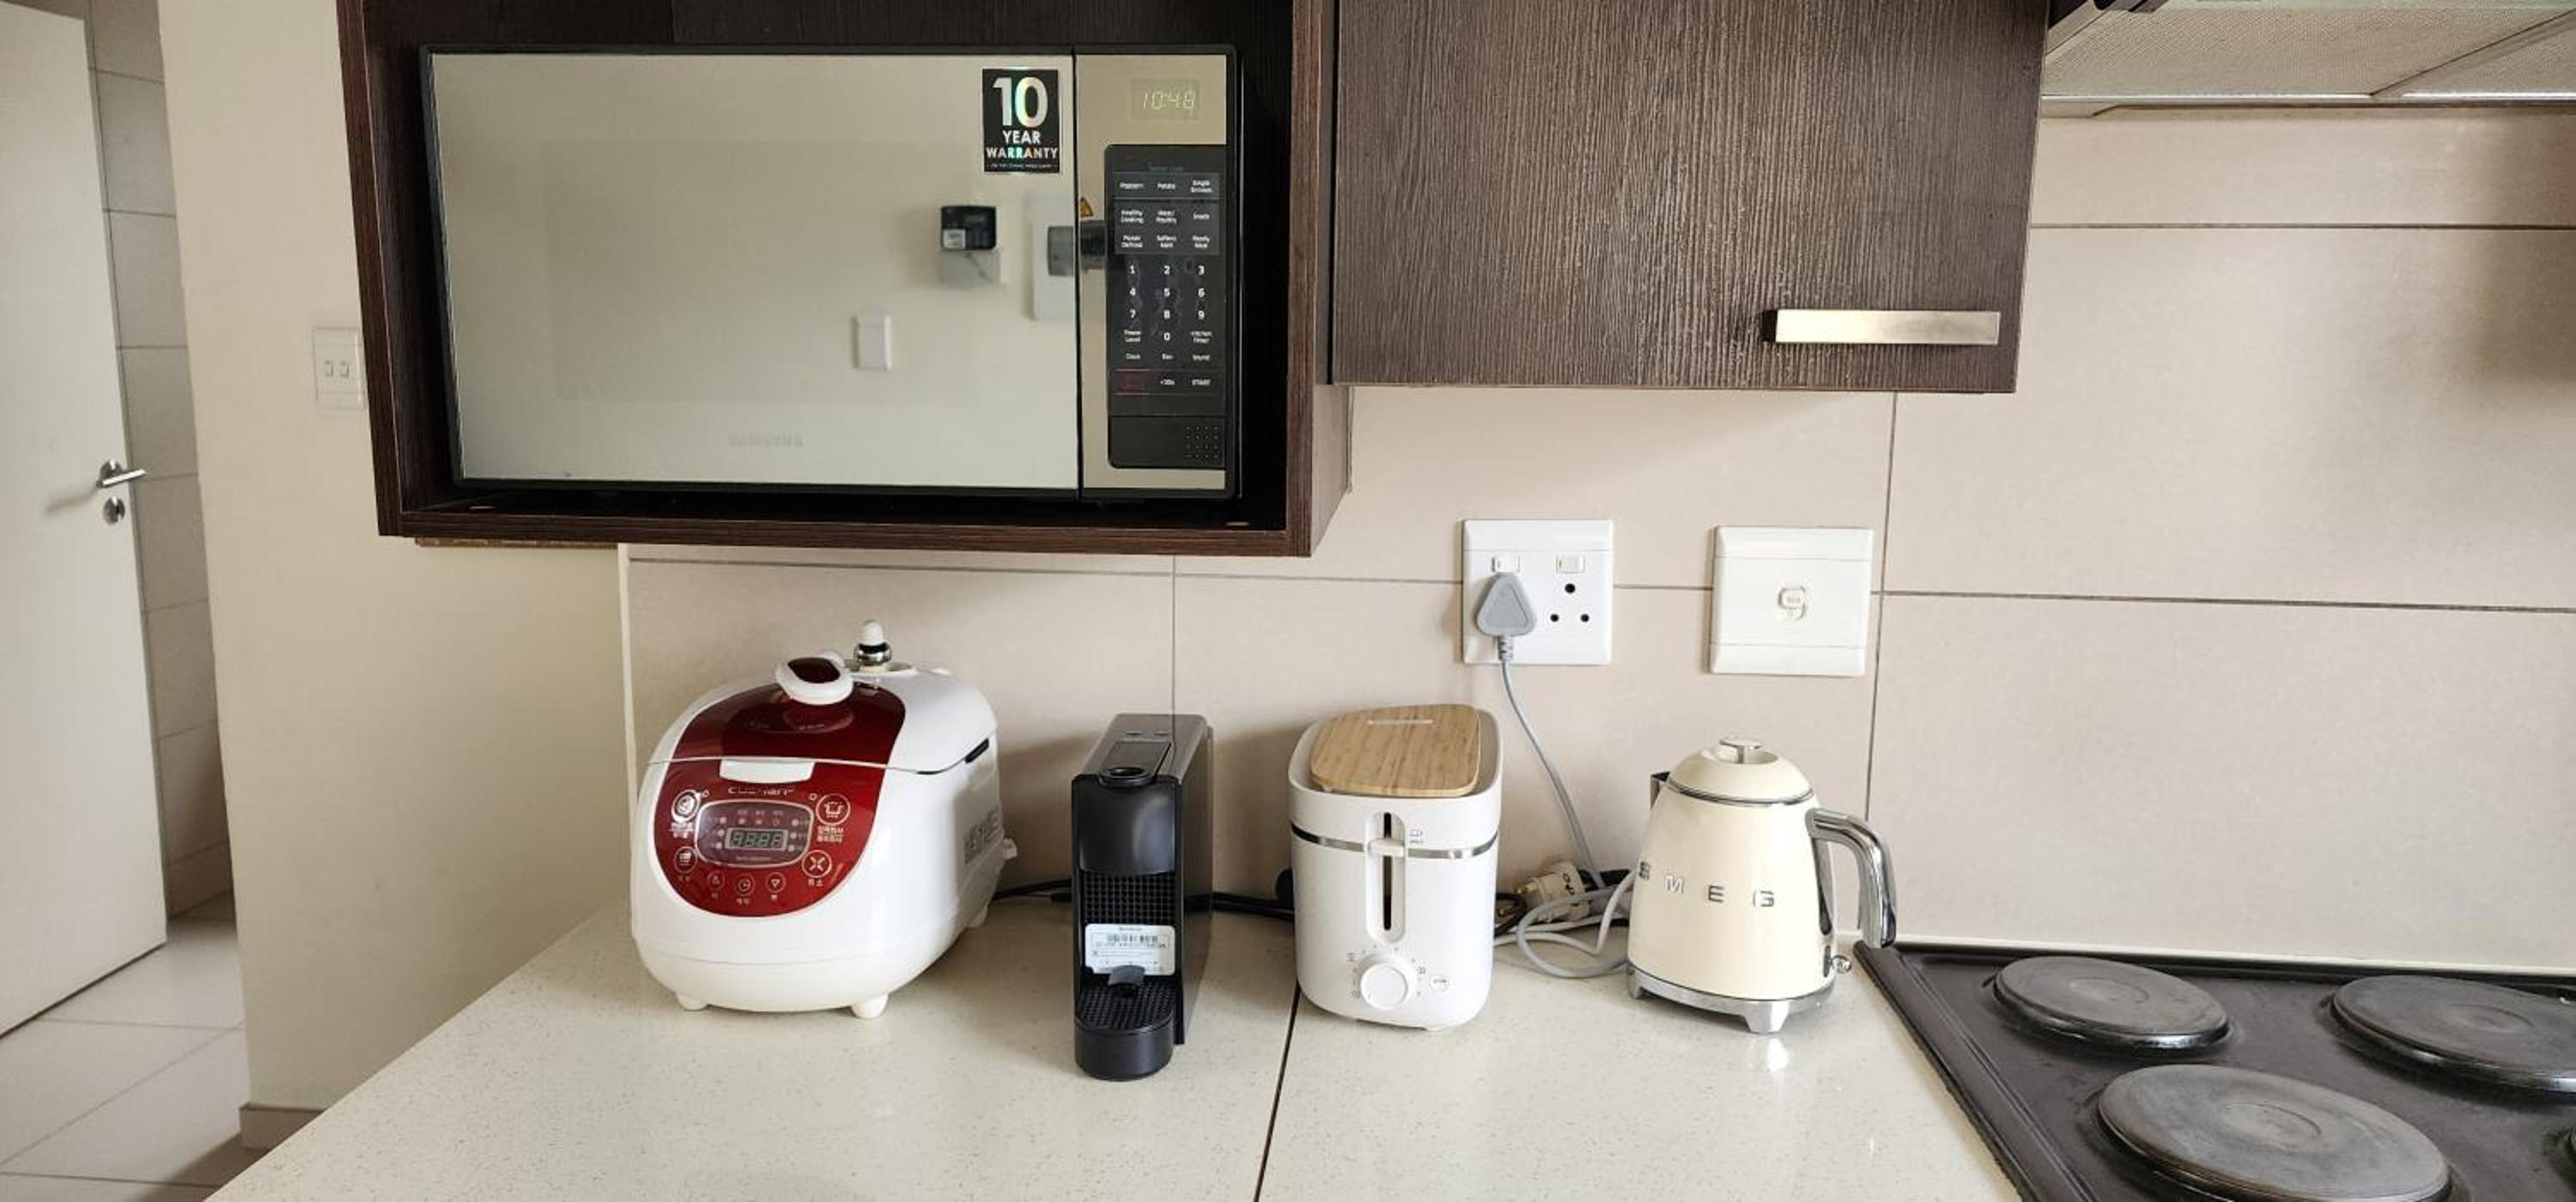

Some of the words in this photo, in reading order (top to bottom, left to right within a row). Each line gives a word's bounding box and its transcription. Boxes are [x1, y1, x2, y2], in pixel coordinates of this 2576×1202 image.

[993, 76, 1048, 128] 10
[1142, 89, 1196, 110] 10:48
[1002, 130, 1042, 144] YEAR
[985, 147, 1059, 159] WARRANTY
[1129, 264, 1135, 274] 1
[1163, 264, 1170, 275] 2
[1198, 264, 1205, 275] 3
[1129, 287, 1136, 296] 4
[1163, 288, 1170, 297] 5
[1198, 288, 1205, 298] 6
[1129, 309, 1136, 319] 7
[1163, 309, 1170, 319] 8
[1198, 310, 1205, 319] 9
[1163, 332, 1170, 341] 0
